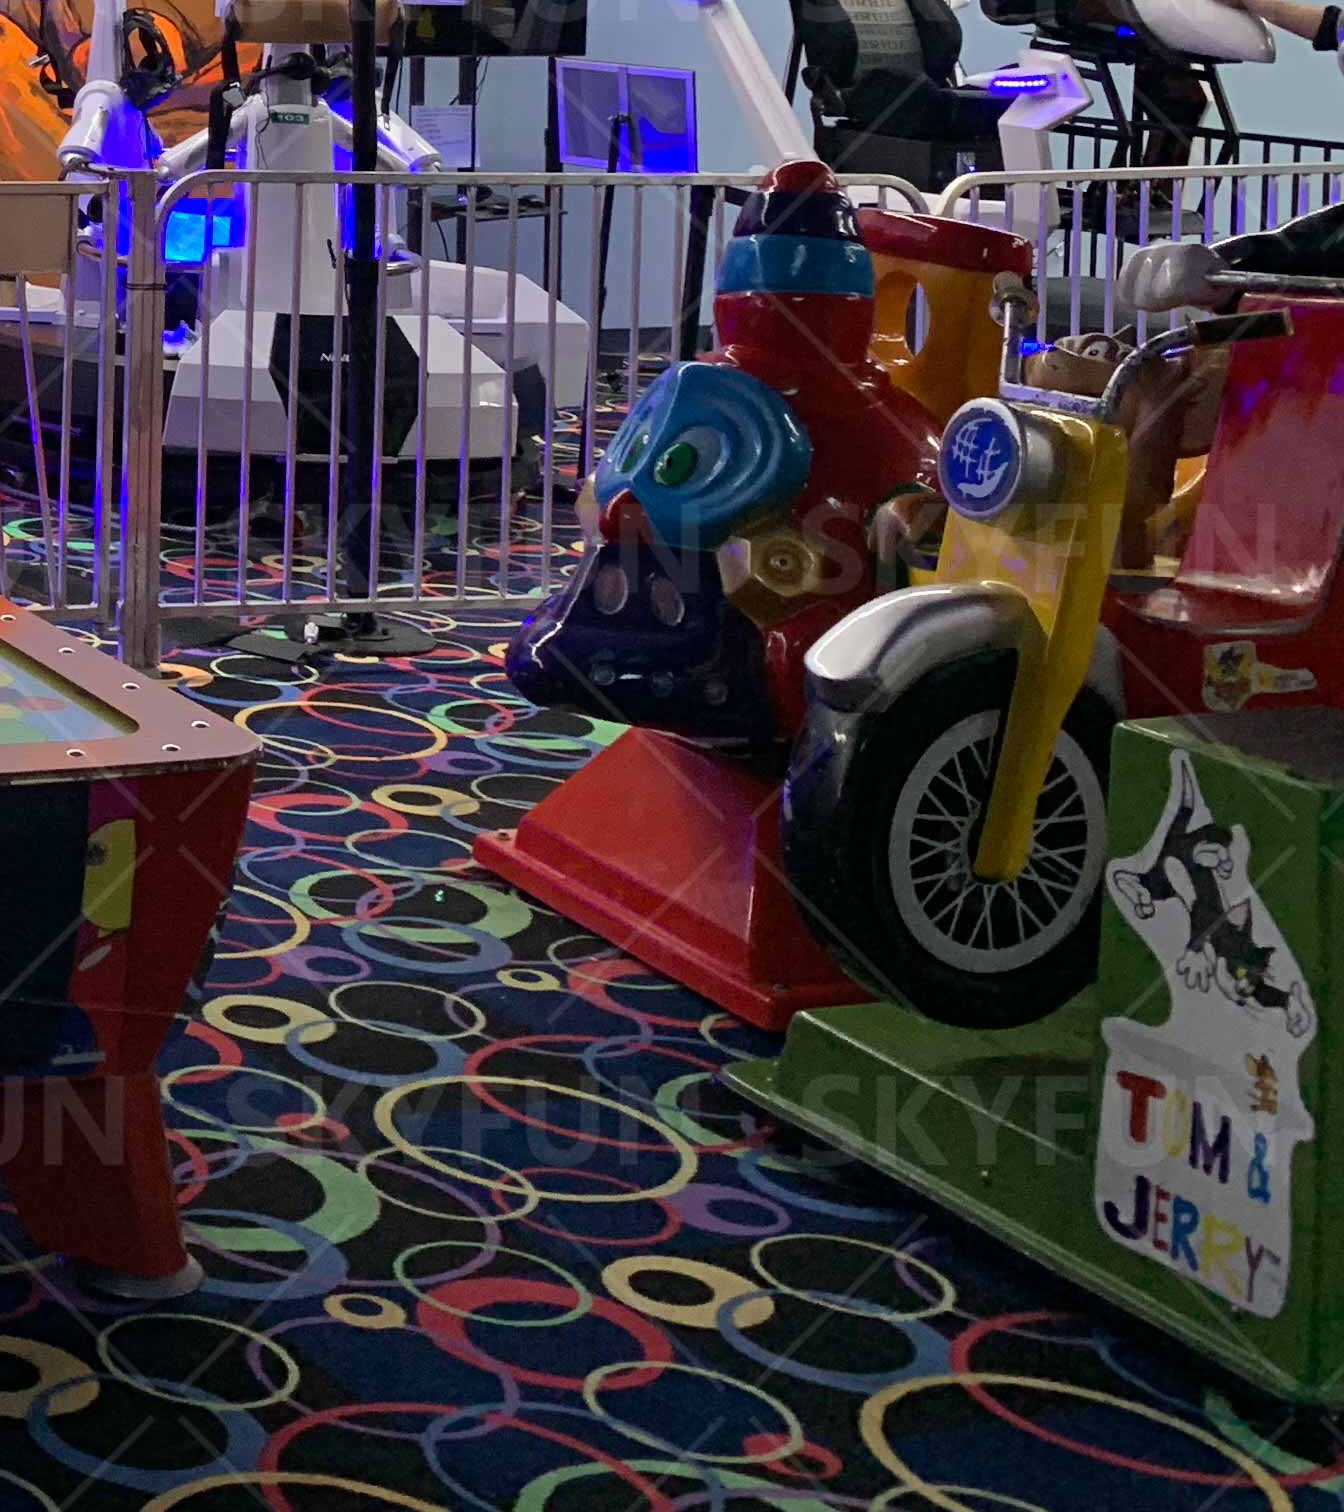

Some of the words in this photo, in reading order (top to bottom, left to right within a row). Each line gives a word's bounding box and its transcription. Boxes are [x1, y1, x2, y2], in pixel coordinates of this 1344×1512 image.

[1117, 1070, 1232, 1185] TOM
[1248, 1133, 1271, 1205] &
[1104, 1175, 1268, 1303] JERRY
